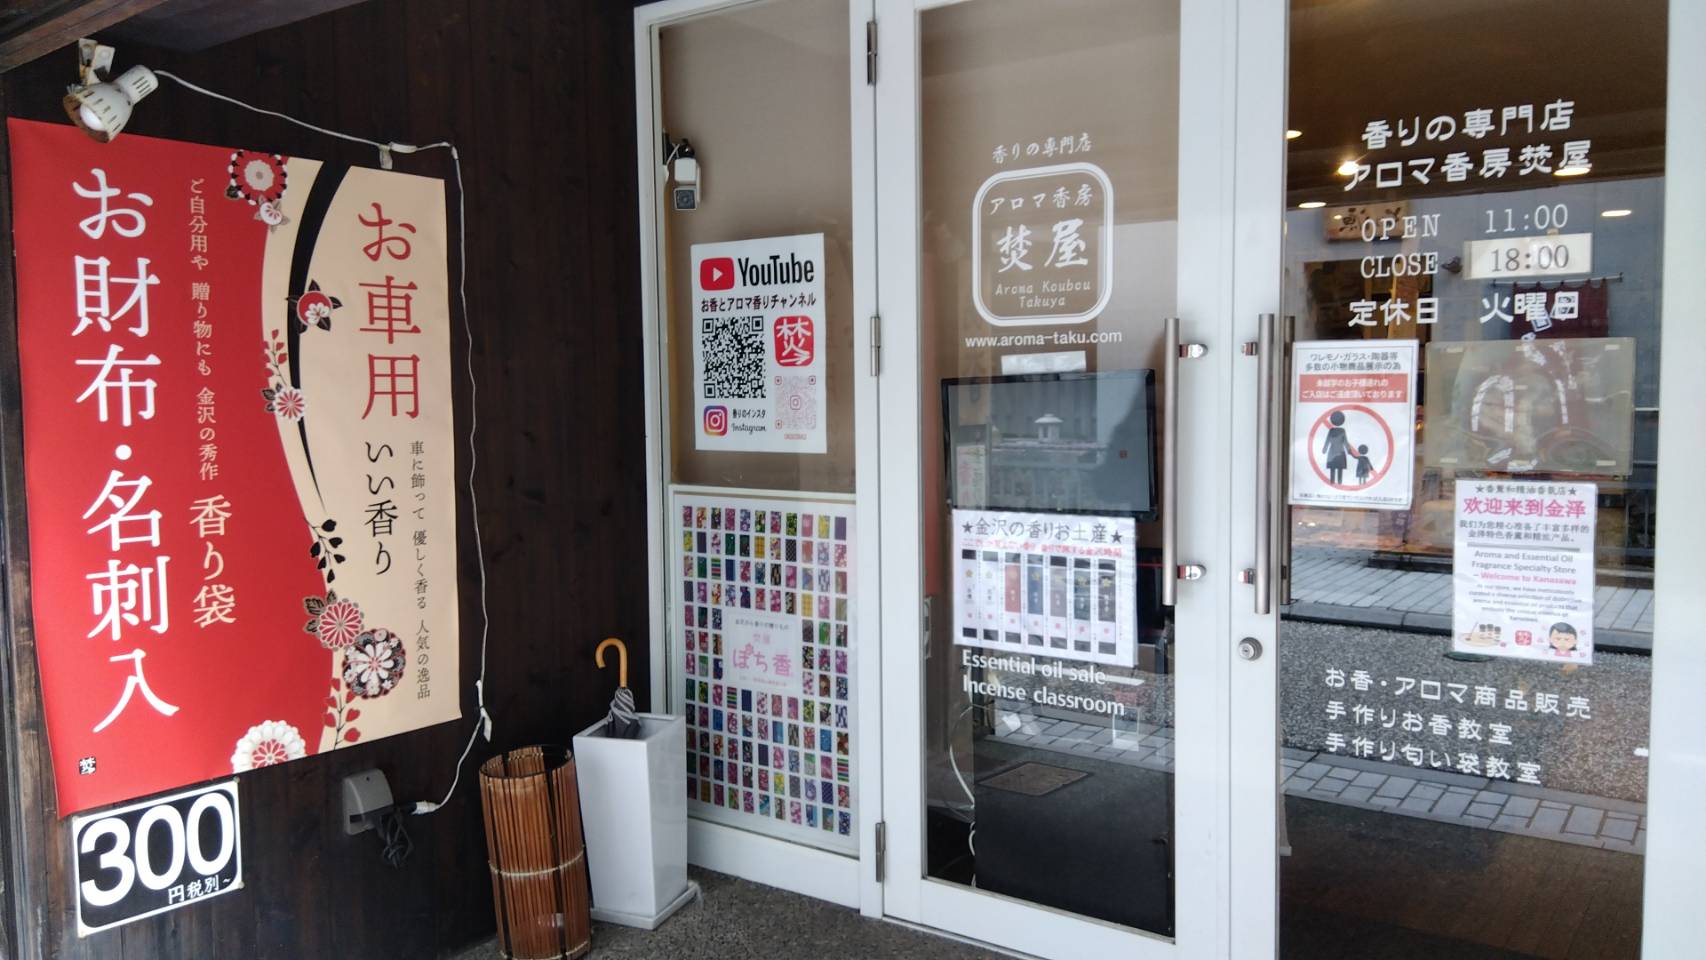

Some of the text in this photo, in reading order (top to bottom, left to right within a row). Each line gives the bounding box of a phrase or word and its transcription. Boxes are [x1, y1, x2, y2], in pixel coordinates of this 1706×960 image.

[1362, 99, 1575, 150] 香りの専門店
[992, 132, 1092, 164] 香りの専門店
[1344, 139, 1593, 191] アロマ香房焚屋
[990, 184, 1093, 215] アロマ香房
[1361, 214, 1440, 242] OPEN
[1485, 204, 1569, 234] 11:00
[996, 218, 1089, 272] 焚屋
[1360, 244, 1569, 279] CLOSE 18:00
[738, 253, 815, 287] YouTube
[995, 279, 1091, 296] Aroma Koubou
[358, 202, 422, 420] お車用
[701, 292, 817, 313] お香とアロマ香りチャンネル
[1019, 295, 1066, 308] Takuya
[1348, 291, 1579, 327] 定休日 火曜日
[188, 177, 219, 481] ご自分用や 贈り物にも 金沢の秀作
[965, 330, 1123, 348] www.aroma-taku.com
[731, 423, 767, 436] Instagram
[71, 168, 179, 733] お財布・名刺入
[364, 441, 399, 576] いい香り
[976, 517, 1108, 543] 金沢の香りお土産
[189, 494, 236, 628] 香り袋
[409, 440, 431, 700] 車に飾って 優しく香る 人気の逸品
[1471, 560, 1512, 570] Fragrance
[1514, 563, 1552, 574] Specialty
[963, 650, 1107, 685] Essential oil sale
[963, 675, 1126, 716] Incense classroom
[1325, 667, 1592, 719] お香・アロマ商品販売
[1326, 701, 1513, 746] 手作りお香教室
[1326, 733, 1542, 785] 手作り匂い袋教室
[80, 792, 236, 907] 300
